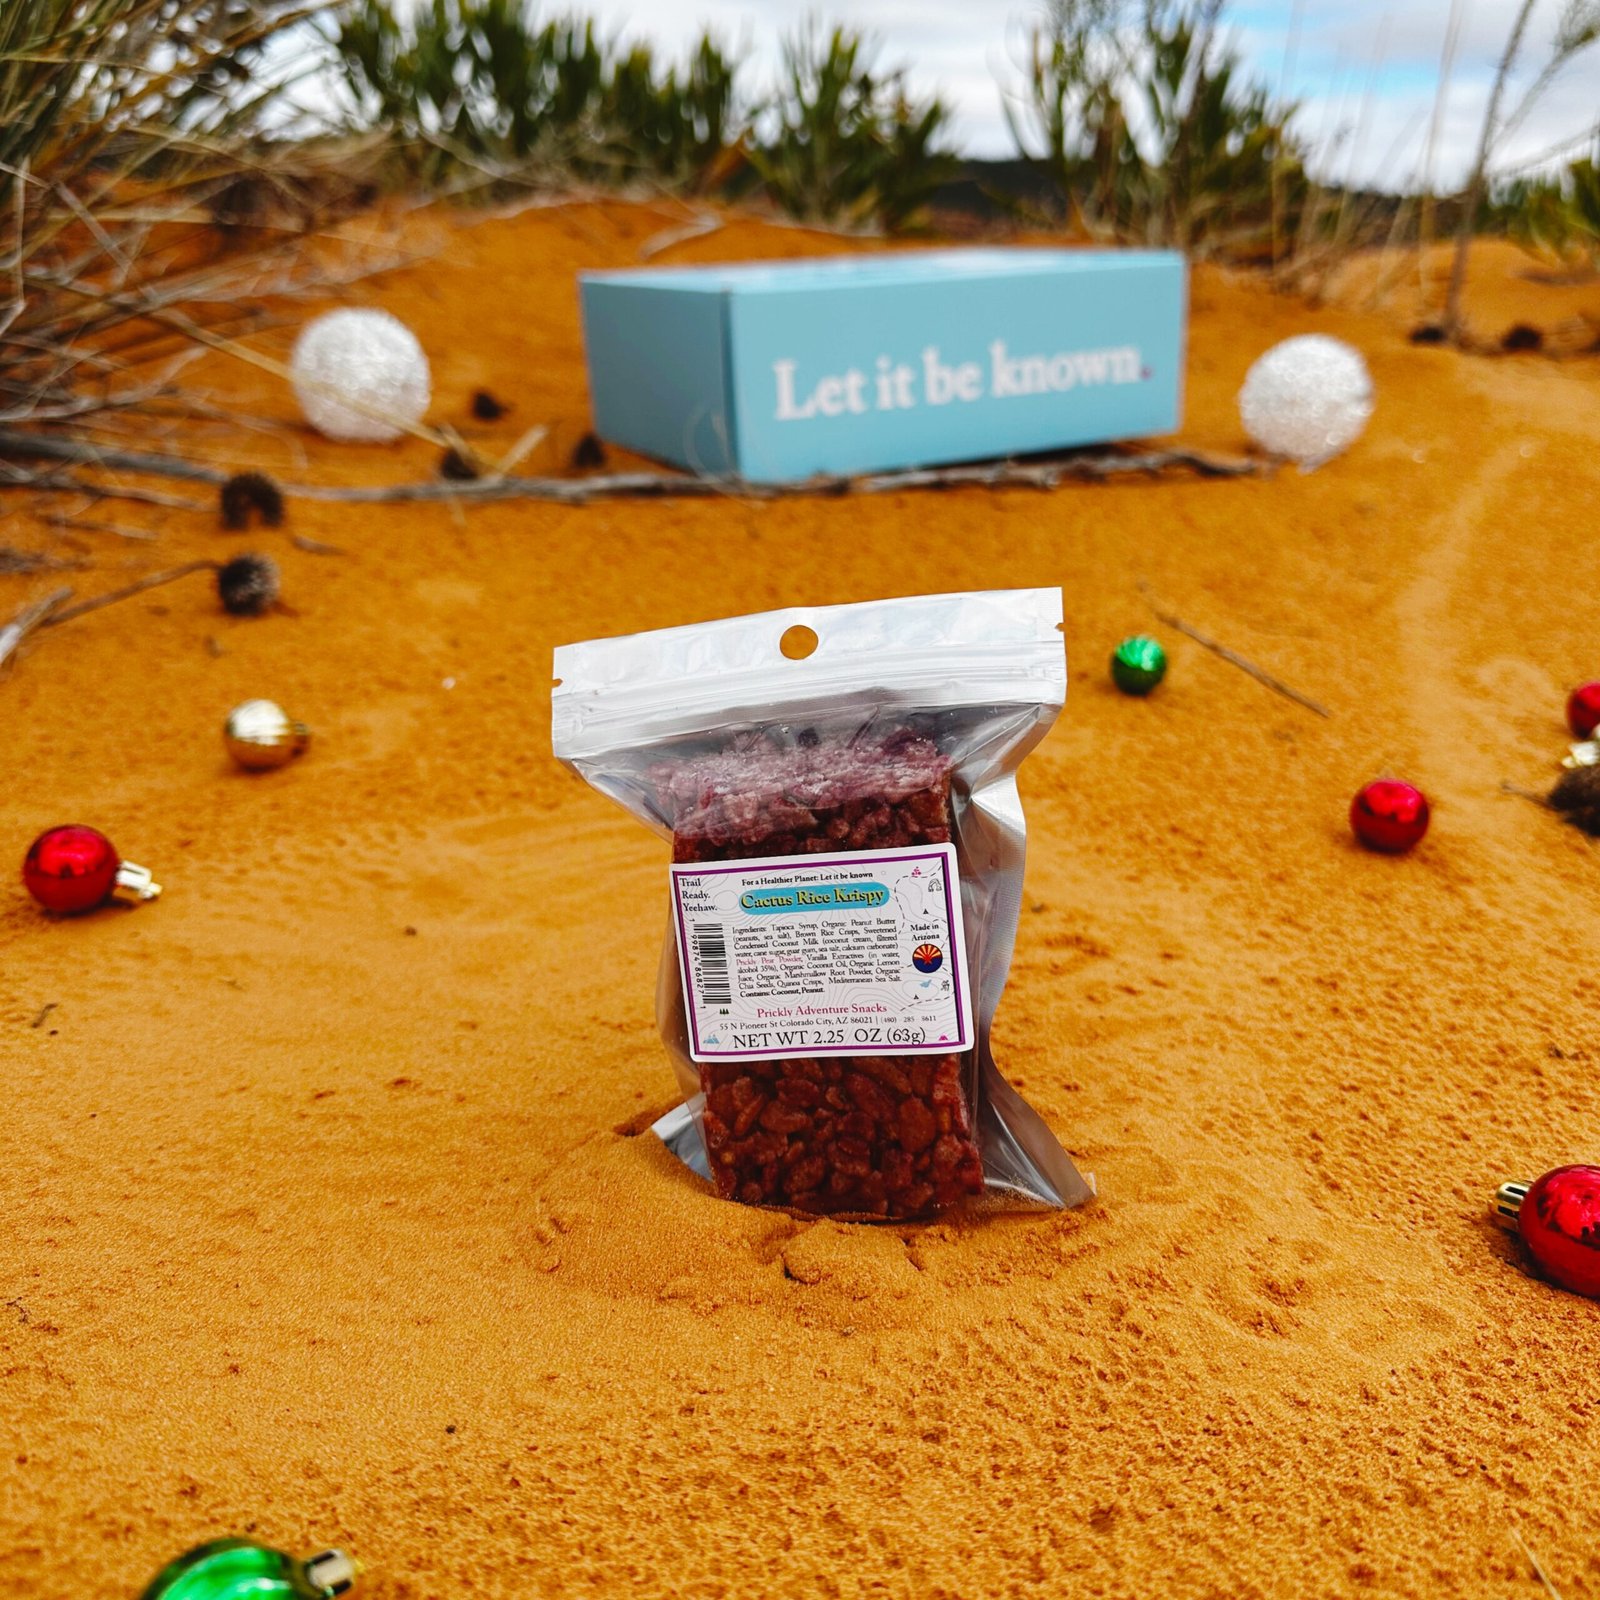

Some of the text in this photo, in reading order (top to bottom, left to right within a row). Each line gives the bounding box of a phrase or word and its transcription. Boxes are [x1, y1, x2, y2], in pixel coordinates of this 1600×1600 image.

[773, 358, 866, 421] Let
[875, 354, 917, 410] it
[922, 344, 981, 406] be
[820, 873, 832, 881] Let
[840, 872, 848, 880] be
[849, 871, 873, 879] known
[681, 878, 701, 886] Trail
[682, 891, 710, 901] Ready.
[741, 888, 884, 909] Cactus Rice Krispy
[683, 903, 717, 912] Yeehaw.
[772, 924, 794, 932] Tapioca
[822, 921, 846, 929] Organic
[864, 926, 896, 934] Sweetened
[910, 922, 939, 931] Made in
[911, 933, 940, 942] Arizona
[734, 942, 768, 950] Condensed
[849, 960, 874, 968] Organic
[876, 967, 900, 975] Organic
[777, 980, 800, 988] Quinoa
[771, 988, 801, 996] Coconut,
[757, 1003, 887, 1018] Prickly Adventure Snacks
[740, 1022, 767, 1030] Pioneer
[780, 1018, 814, 1027] Colorado
[733, 1027, 926, 1048] NET WT 2.25 OZ (63g)
